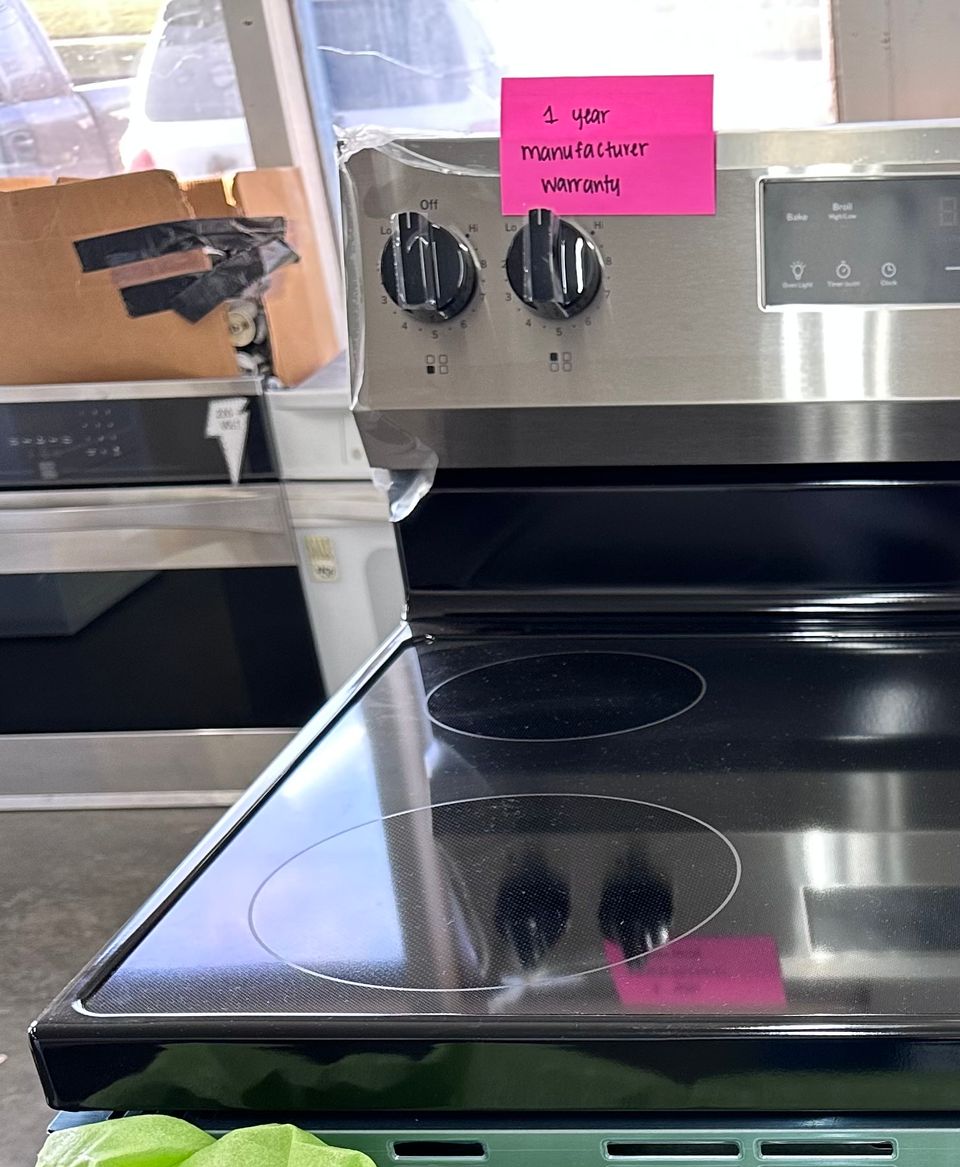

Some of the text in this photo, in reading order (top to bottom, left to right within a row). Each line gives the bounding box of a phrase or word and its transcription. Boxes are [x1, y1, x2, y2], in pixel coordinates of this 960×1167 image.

[543, 105, 611, 130] 1 year
[521, 139, 650, 162] manufacturer
[541, 175, 621, 197] warranty
[420, 199, 439, 210] Off
[381, 226, 392, 235] Lo
[469, 224, 478, 233] Hi
[505, 223, 517, 233] Lo
